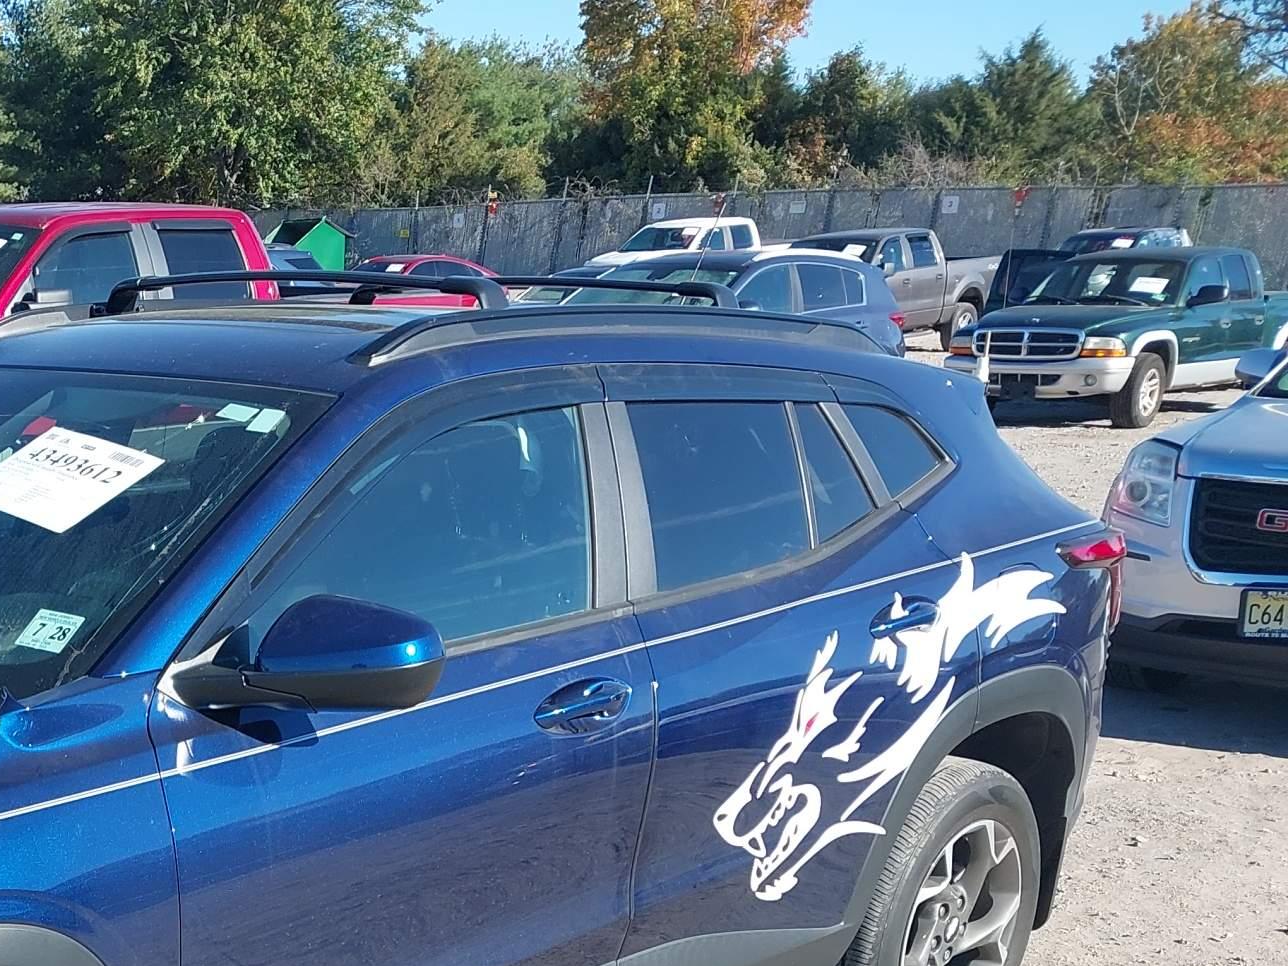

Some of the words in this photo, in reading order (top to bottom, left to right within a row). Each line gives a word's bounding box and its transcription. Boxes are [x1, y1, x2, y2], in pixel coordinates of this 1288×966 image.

[29, 447, 123, 485] 43493612
[1248, 603, 1285, 626] C64
[32, 622, 48, 637] 7
[48, 625, 71, 642] 28
